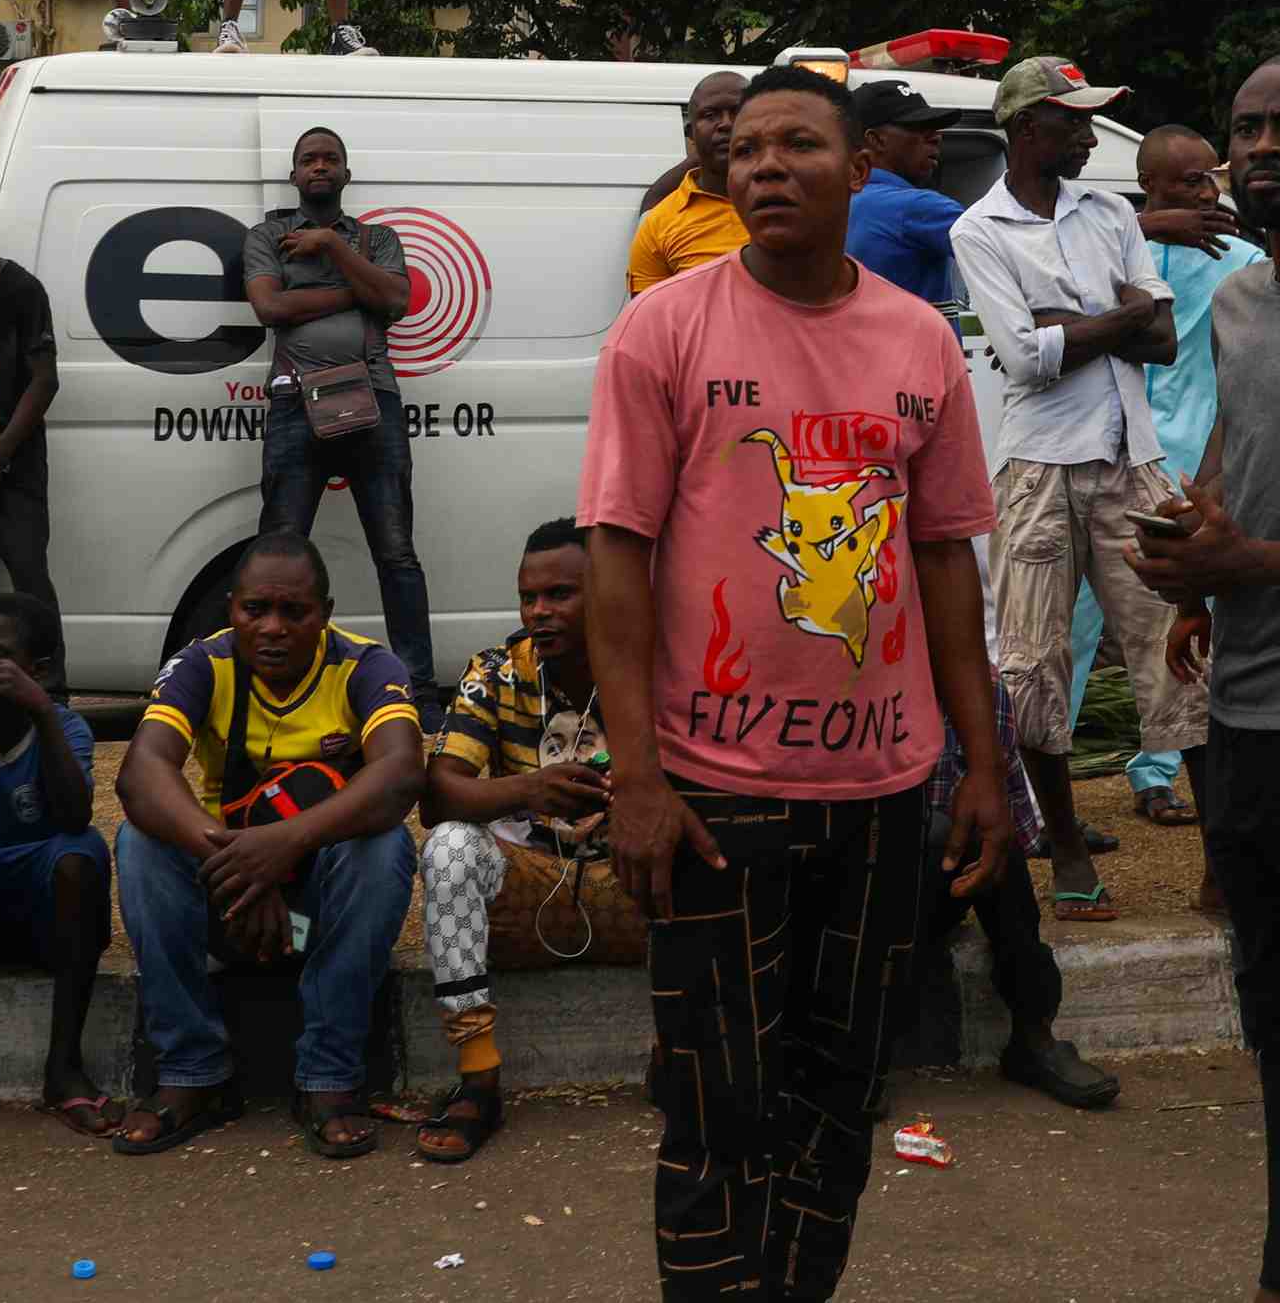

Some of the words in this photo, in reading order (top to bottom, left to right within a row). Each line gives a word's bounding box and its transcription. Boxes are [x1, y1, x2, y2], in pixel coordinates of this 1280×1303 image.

[153, 405, 267, 442] DOWNH
[452, 402, 496, 437] OR
[706, 379, 761, 409] FVE
[895, 390, 936, 424] ONE
[687, 689, 910, 753] FIVEONE
